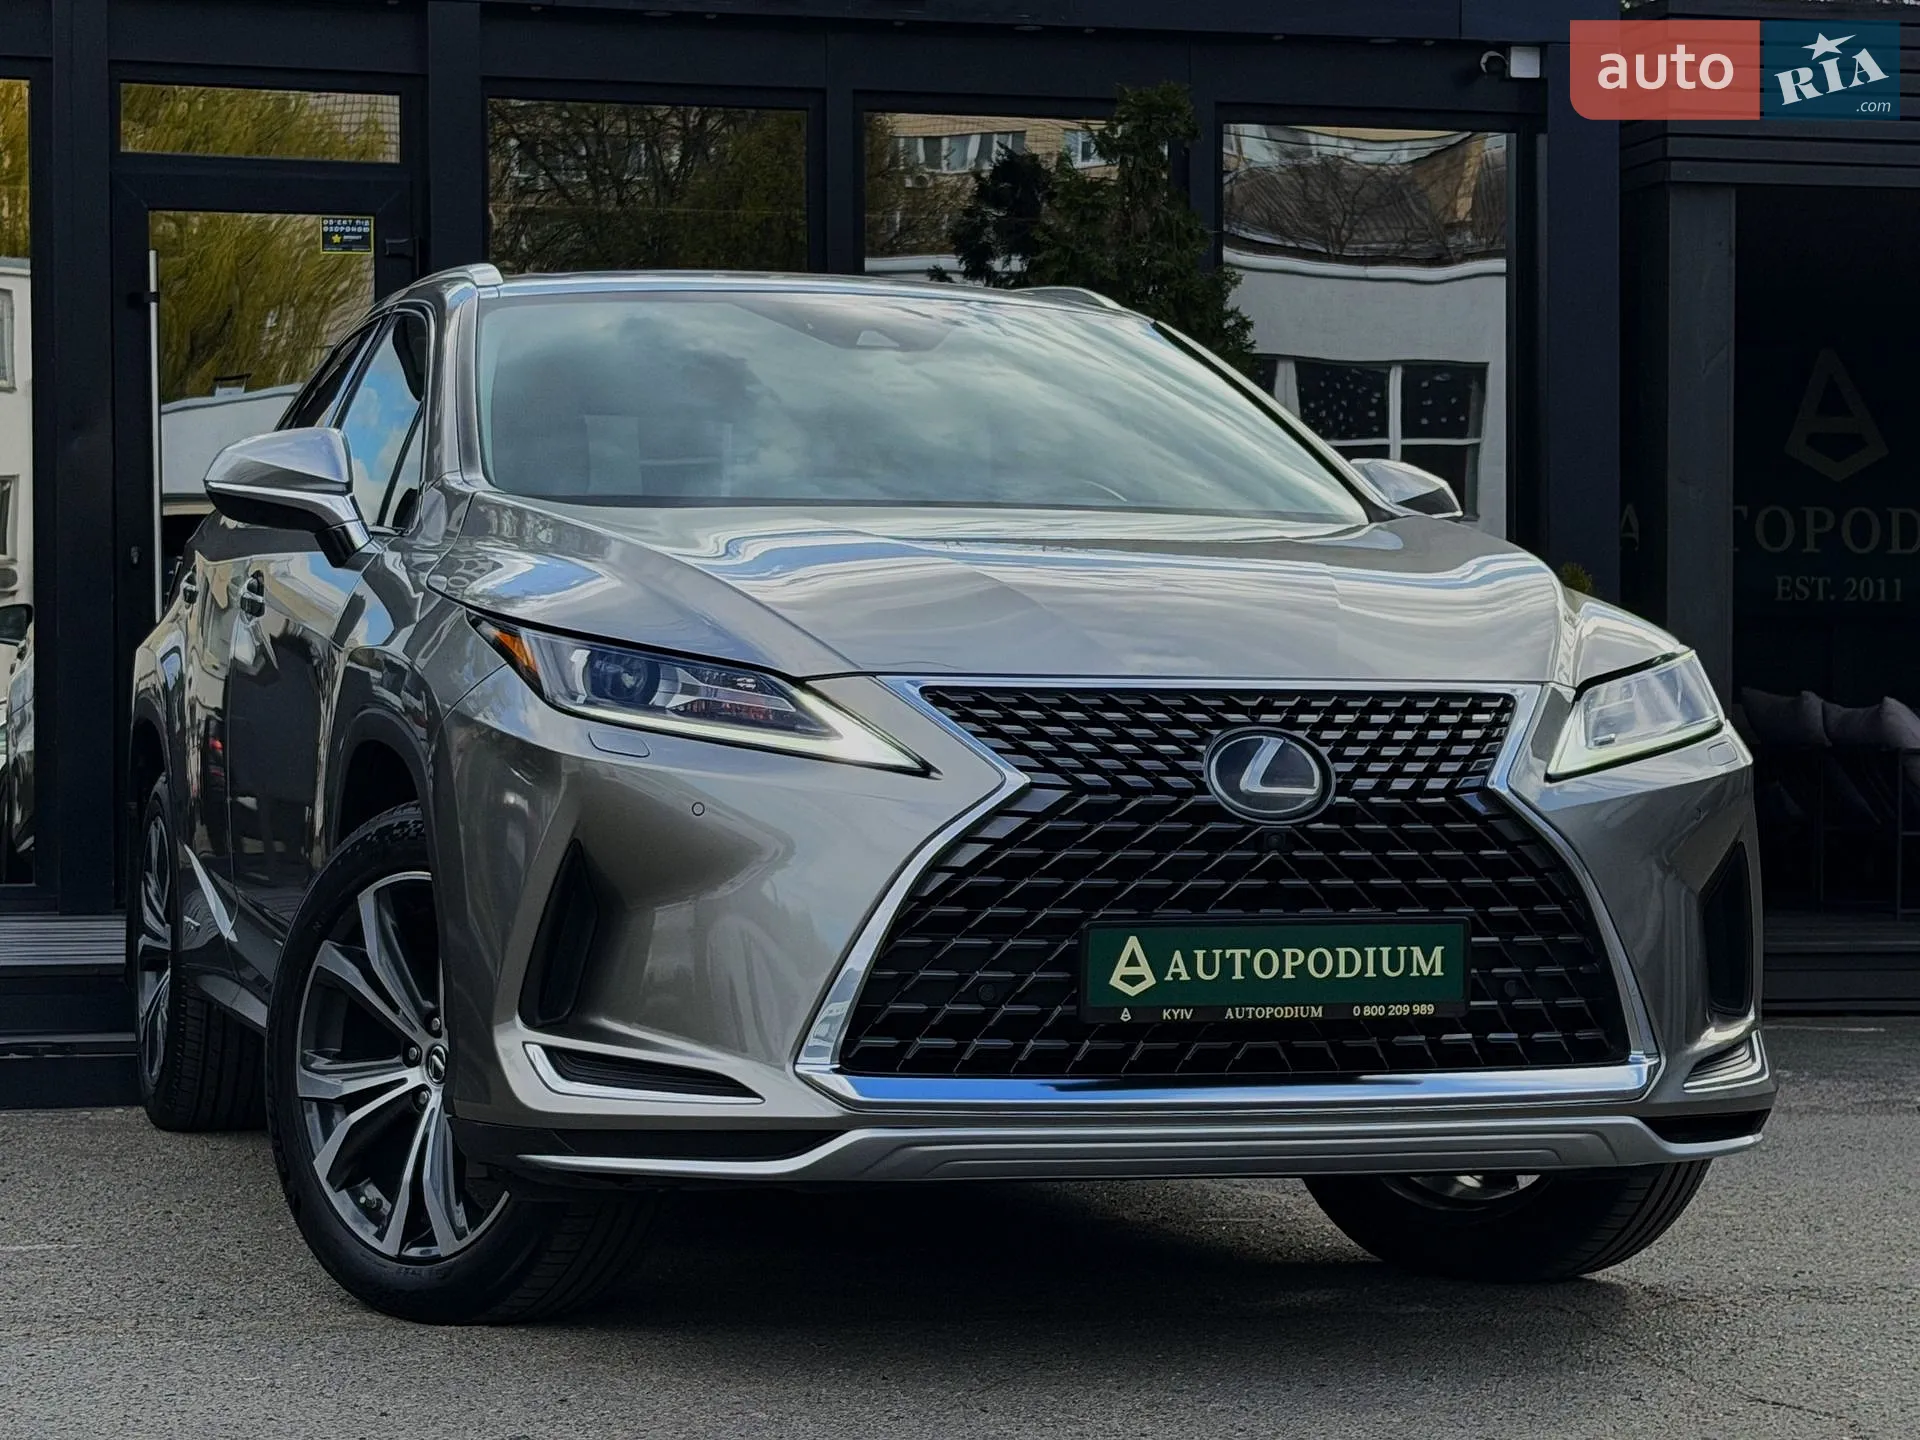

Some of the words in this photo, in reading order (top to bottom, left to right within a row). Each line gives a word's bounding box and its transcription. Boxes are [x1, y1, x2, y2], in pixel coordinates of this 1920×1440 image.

[1773, 575, 1836, 602] EST.
[1843, 576, 1904, 603] 2011
[1164, 946, 1445, 981] AUTOPODIUM
[1162, 1008, 1194, 1020] KYIV
[1224, 1006, 1323, 1019] AUTOPODIUM
[1352, 1005, 1360, 1017] 0
[1363, 1005, 1385, 1017] 800
[1387, 1004, 1410, 1016] 209
[1412, 1004, 1435, 1016] 989
